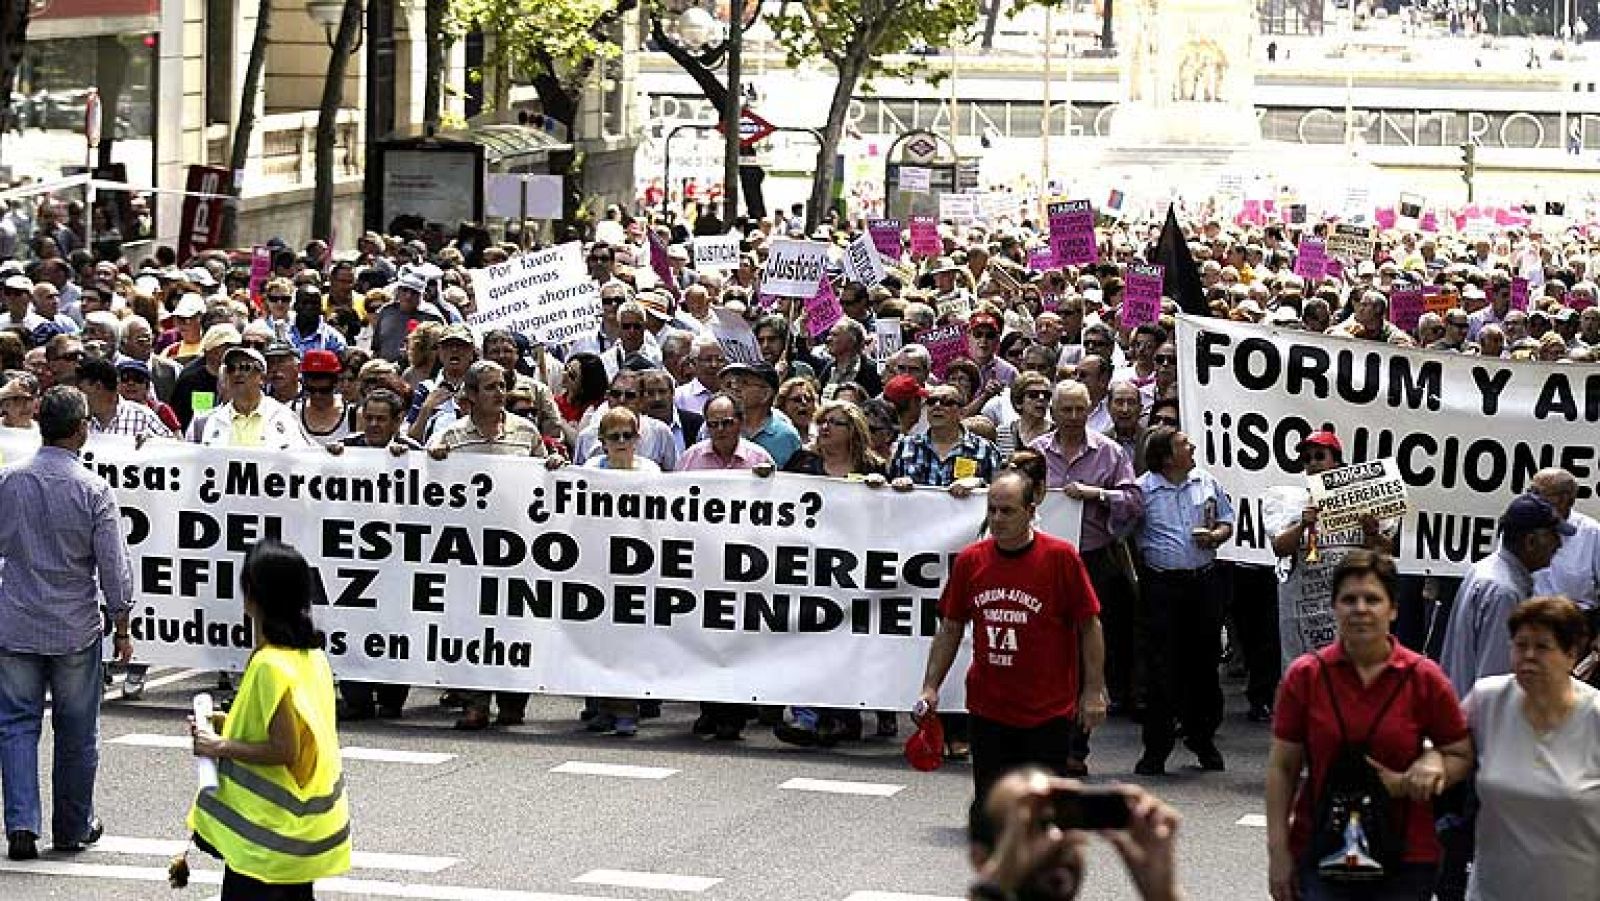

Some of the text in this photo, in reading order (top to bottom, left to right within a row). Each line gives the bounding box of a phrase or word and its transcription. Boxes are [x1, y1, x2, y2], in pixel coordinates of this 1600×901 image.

[488, 252, 563, 280] Por favor,
[489, 270, 560, 300] queremos
[469, 282, 595, 325] nuestros ahorros
[1195, 330, 1442, 411] FORUM
[1472, 366, 1513, 416] Y
[1203, 410, 1600, 500] ¡¡SOUCIONE
[199, 460, 494, 510] ¿Mercantiles?
[528, 478, 823, 529] ¿Financieras?
[1318, 480, 1403, 511] PREFERENTES
[322, 518, 580, 573] ESTADO
[609, 535, 695, 579] DE
[723, 542, 958, 590] DEREC
[1416, 511, 1502, 564] NUE
[141, 556, 380, 608] EFIAZ
[411, 572, 447, 612] E
[364, 633, 410, 661] en
[426, 623, 532, 668] lucha
[985, 626, 1018, 651] YA
